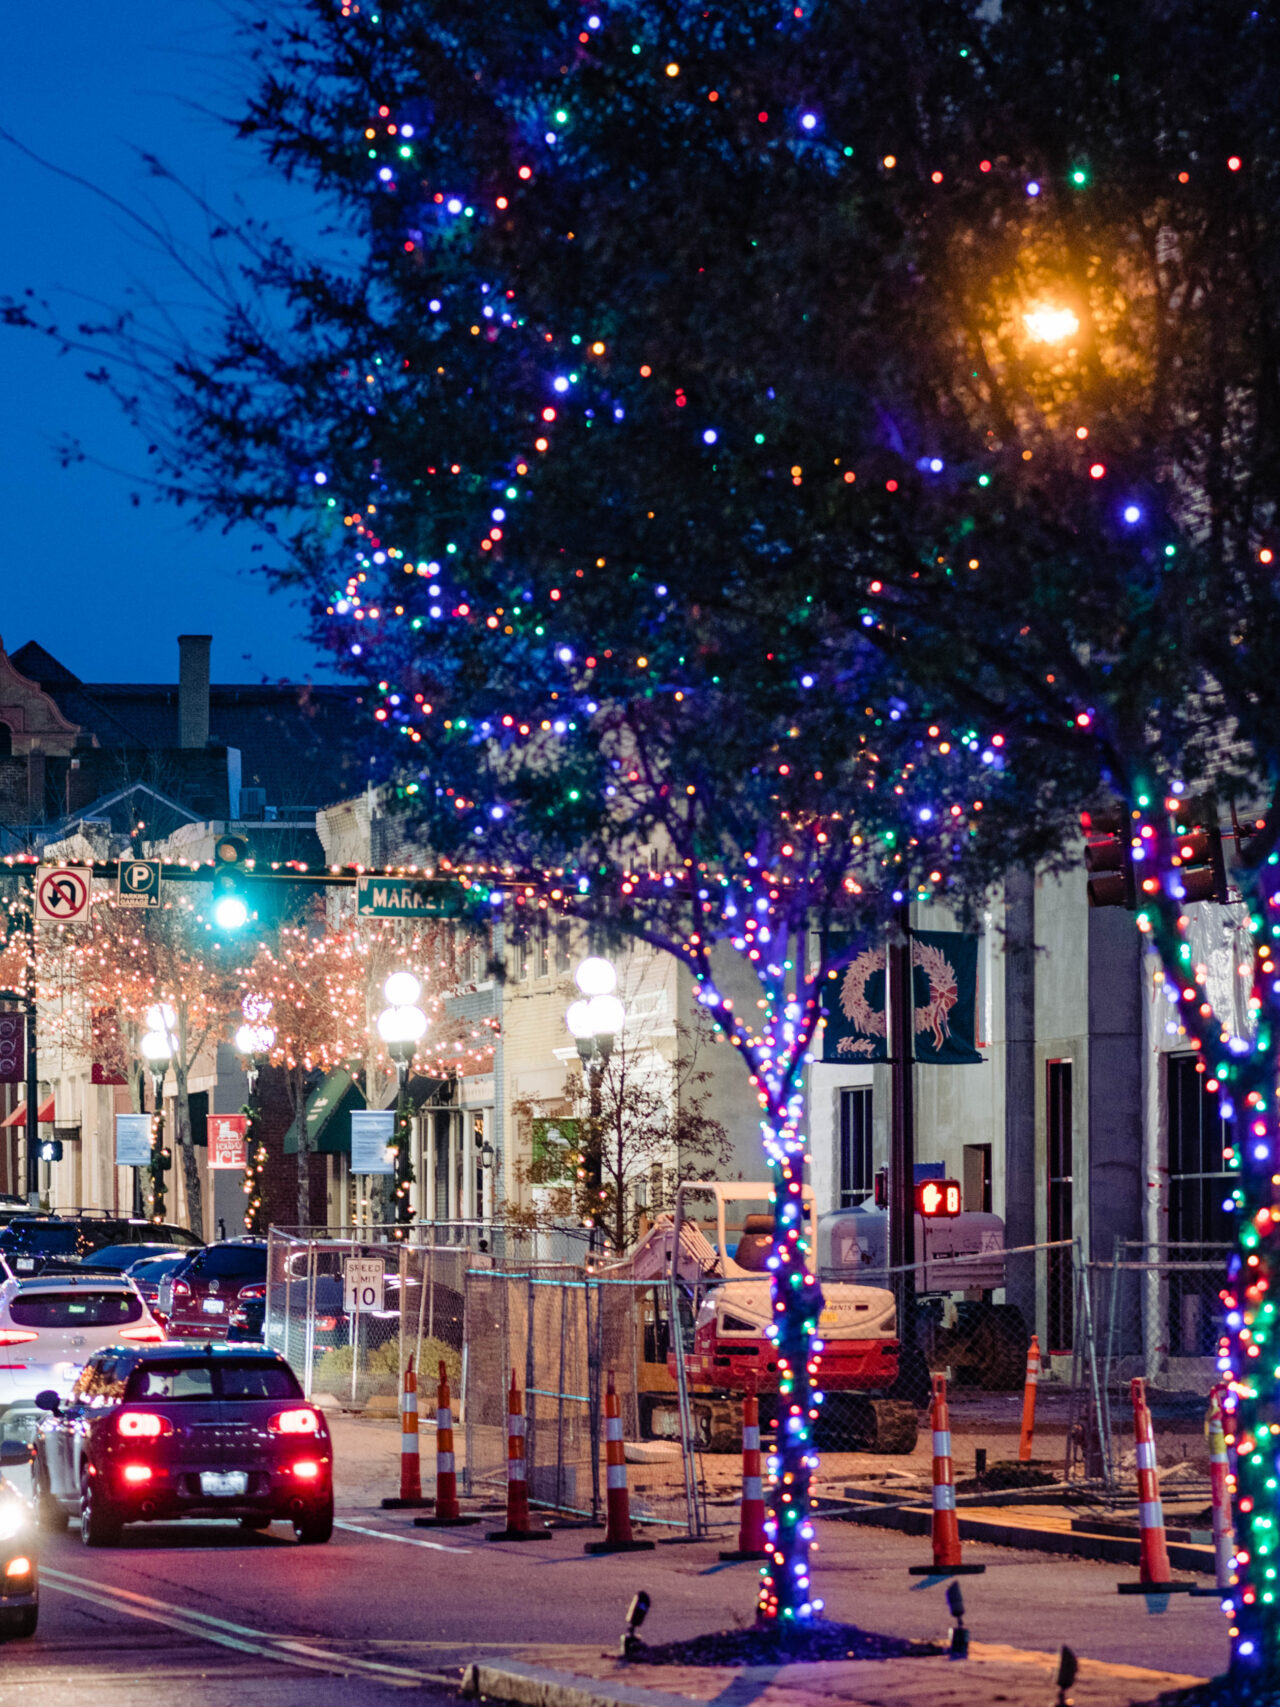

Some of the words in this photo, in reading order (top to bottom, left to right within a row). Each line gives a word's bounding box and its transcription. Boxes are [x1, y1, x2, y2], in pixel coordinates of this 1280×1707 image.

[132, 866, 149, 888] P
[360, 879, 369, 891] W
[216, 1150, 243, 1165] ICE
[352, 1287, 376, 1306] 10
